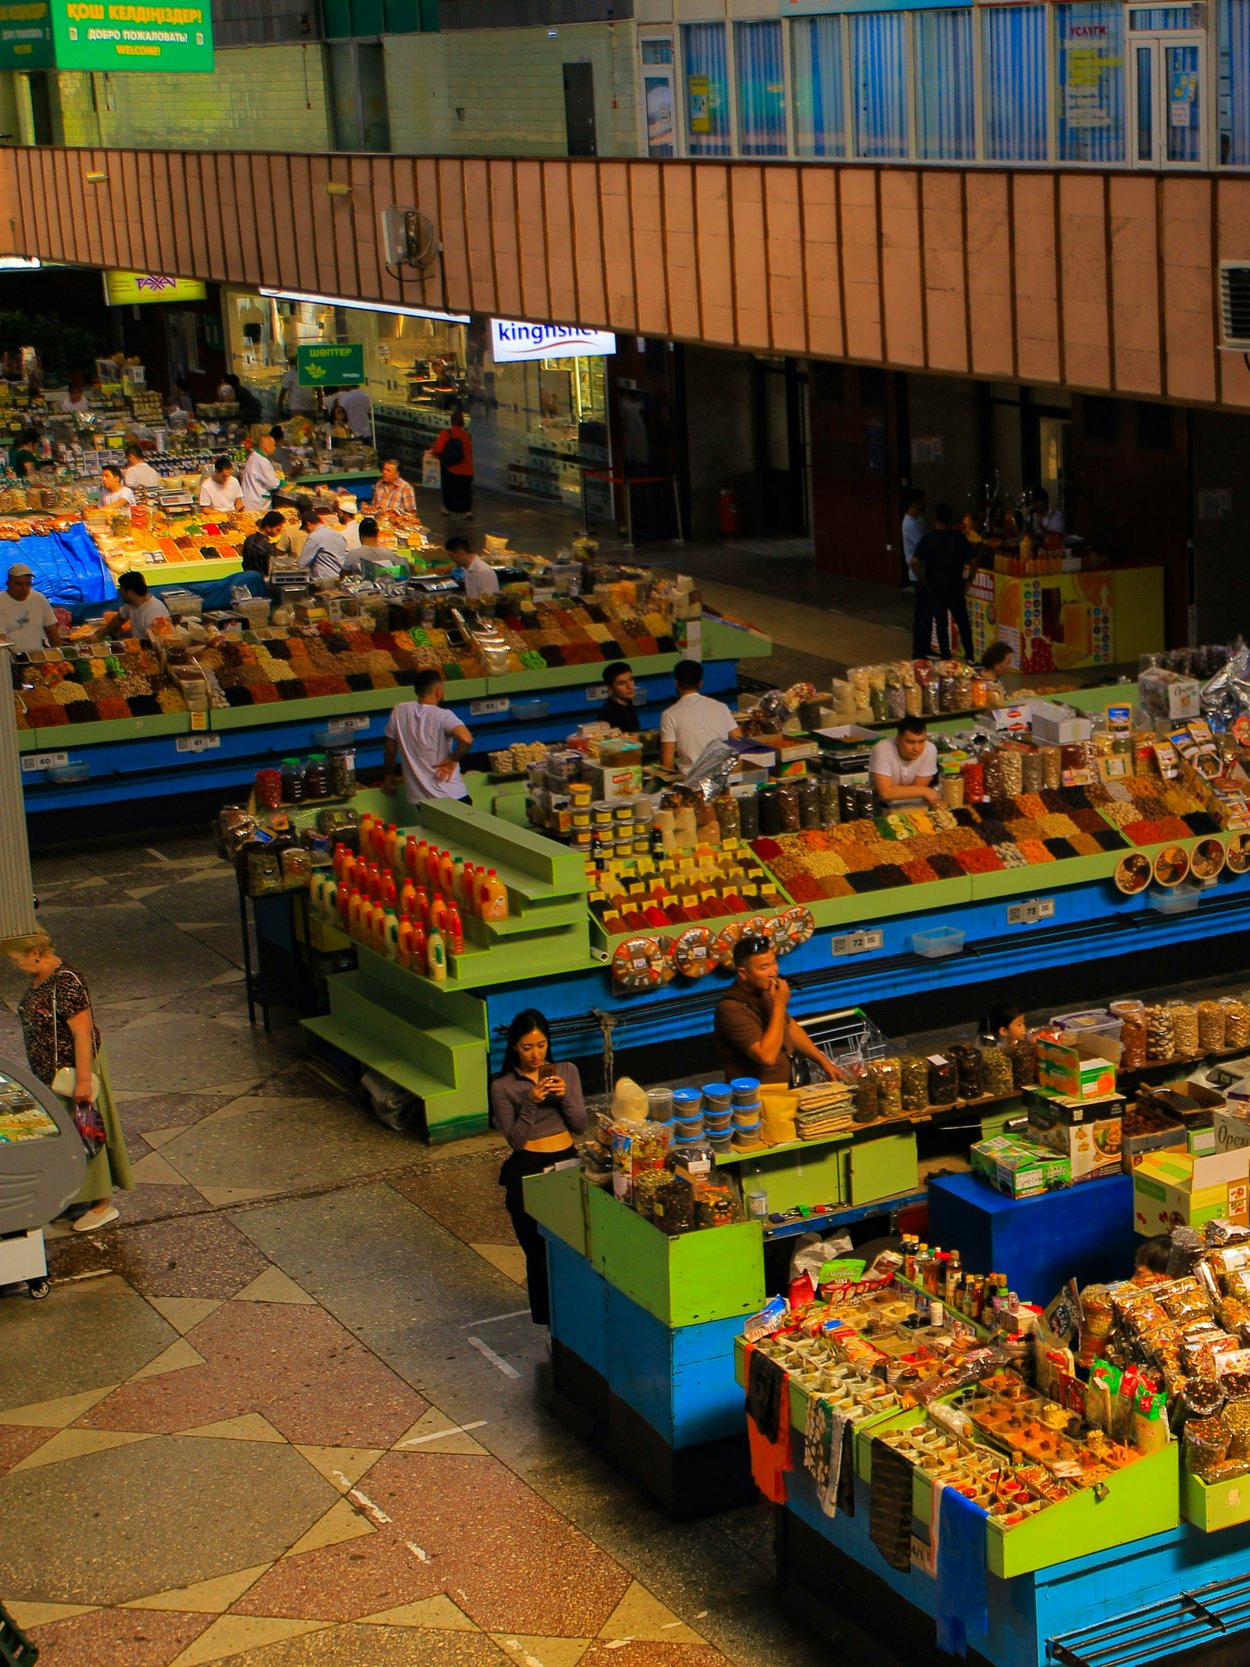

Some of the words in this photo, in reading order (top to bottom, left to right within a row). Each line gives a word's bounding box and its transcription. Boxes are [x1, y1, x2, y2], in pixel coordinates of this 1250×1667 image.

[66, 3, 104, 21] ҚОШ
[88, 28, 121, 41] ДОБРО
[122, 30, 188, 43] ПОЖАЛОВАТЬ!
[116, 44, 160, 56] WELCOME!
[309, 348, 352, 358] ШӨПТЕР
[853, 939, 863, 947] 72
